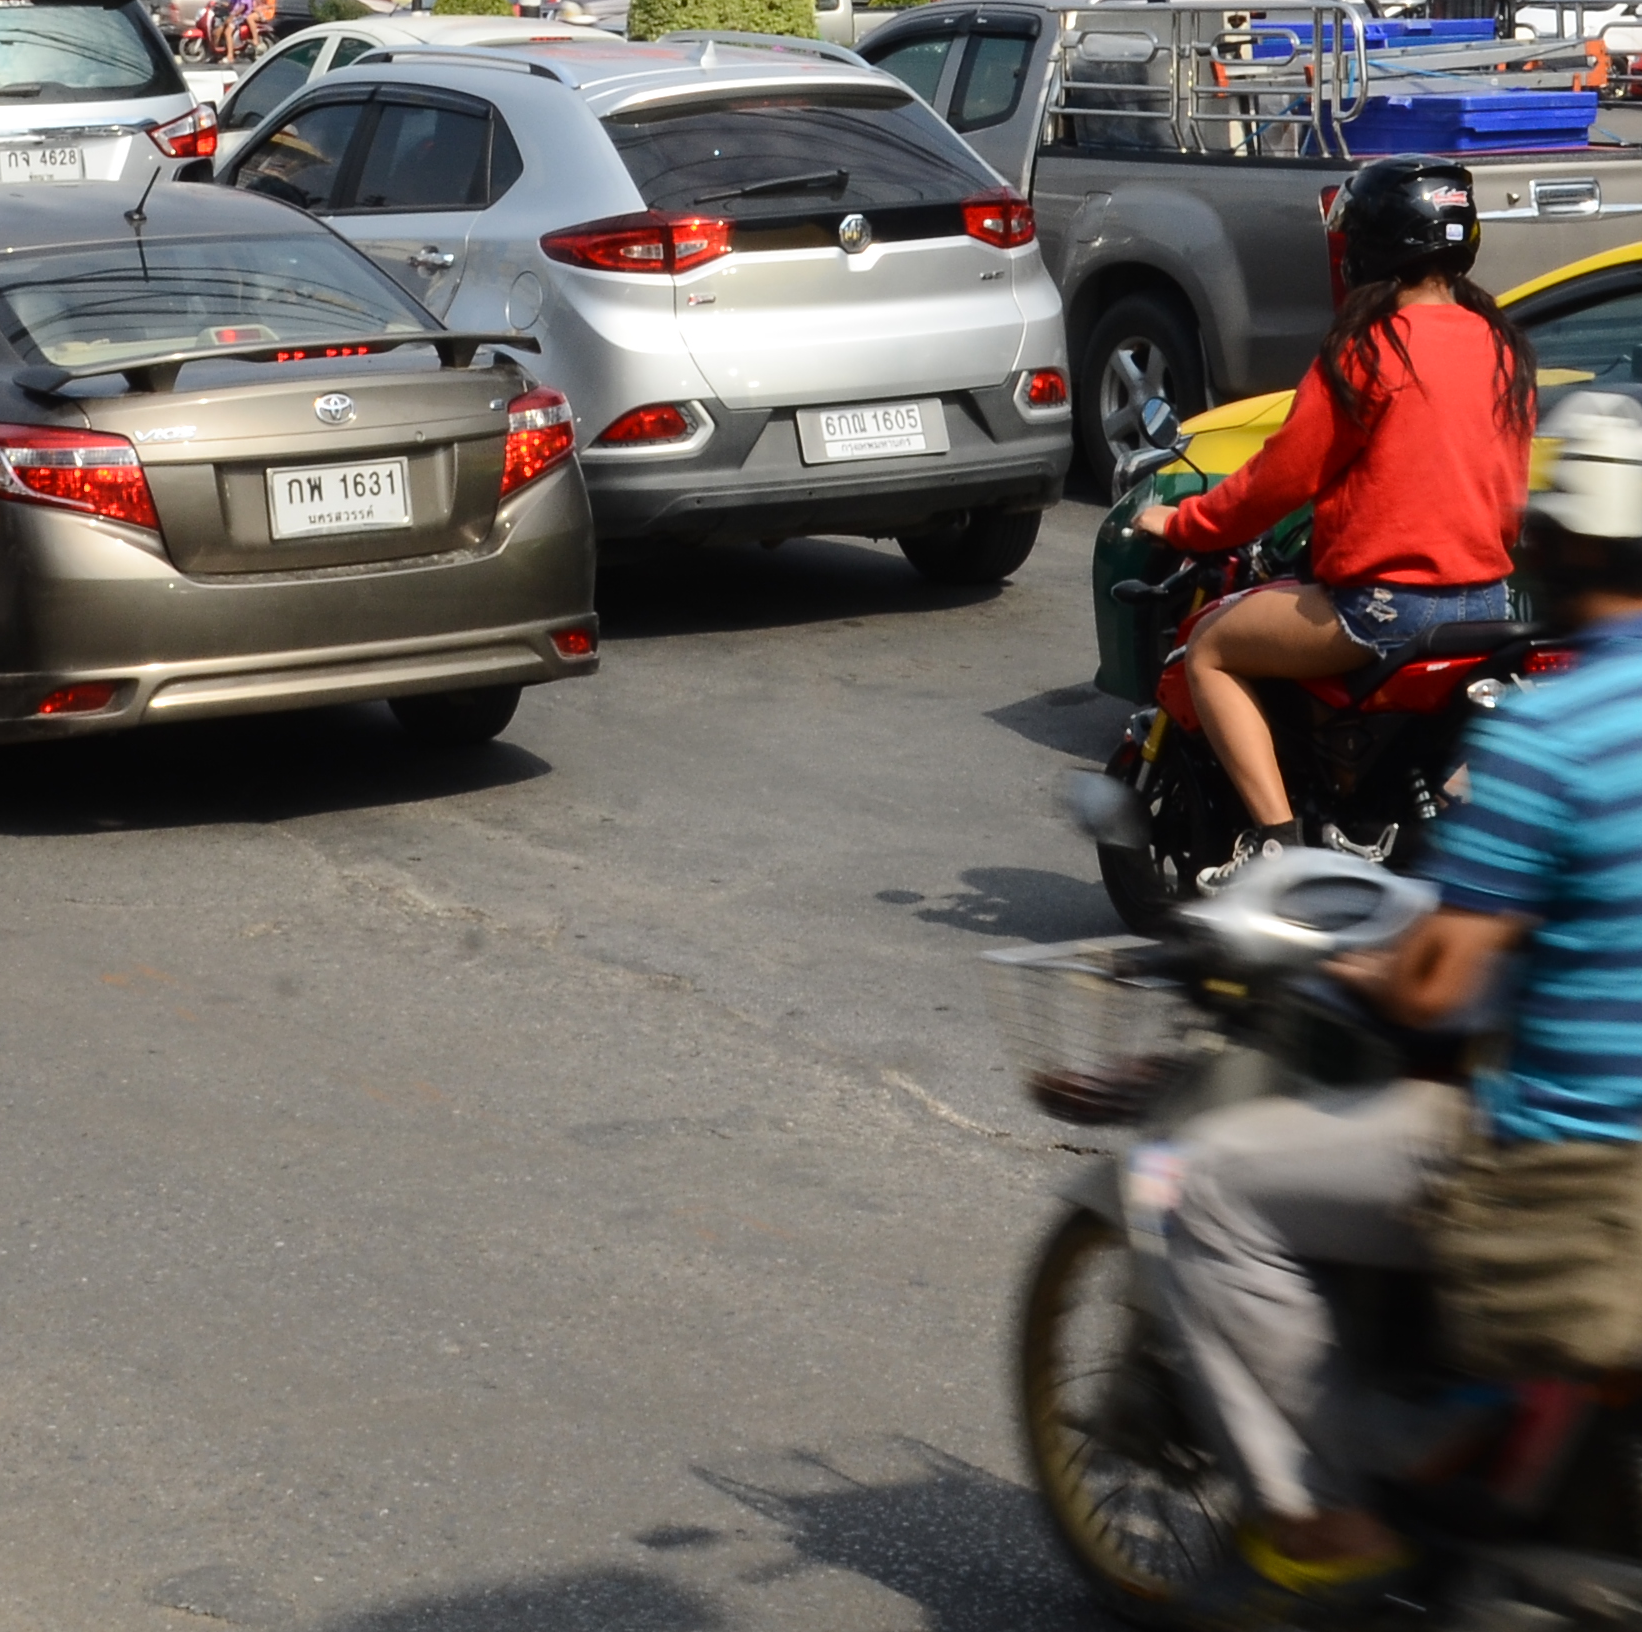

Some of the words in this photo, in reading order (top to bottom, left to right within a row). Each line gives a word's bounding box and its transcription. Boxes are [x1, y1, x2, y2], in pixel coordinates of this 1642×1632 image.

[8, 151, 30, 168] กจ
[40, 149, 78, 166] 4628
[872, 409, 918, 432] 1605
[133, 425, 197, 442] VIOS
[286, 475, 324, 504] กพ
[339, 470, 395, 499] 1631
[308, 504, 375, 524] นครสวรรค์
